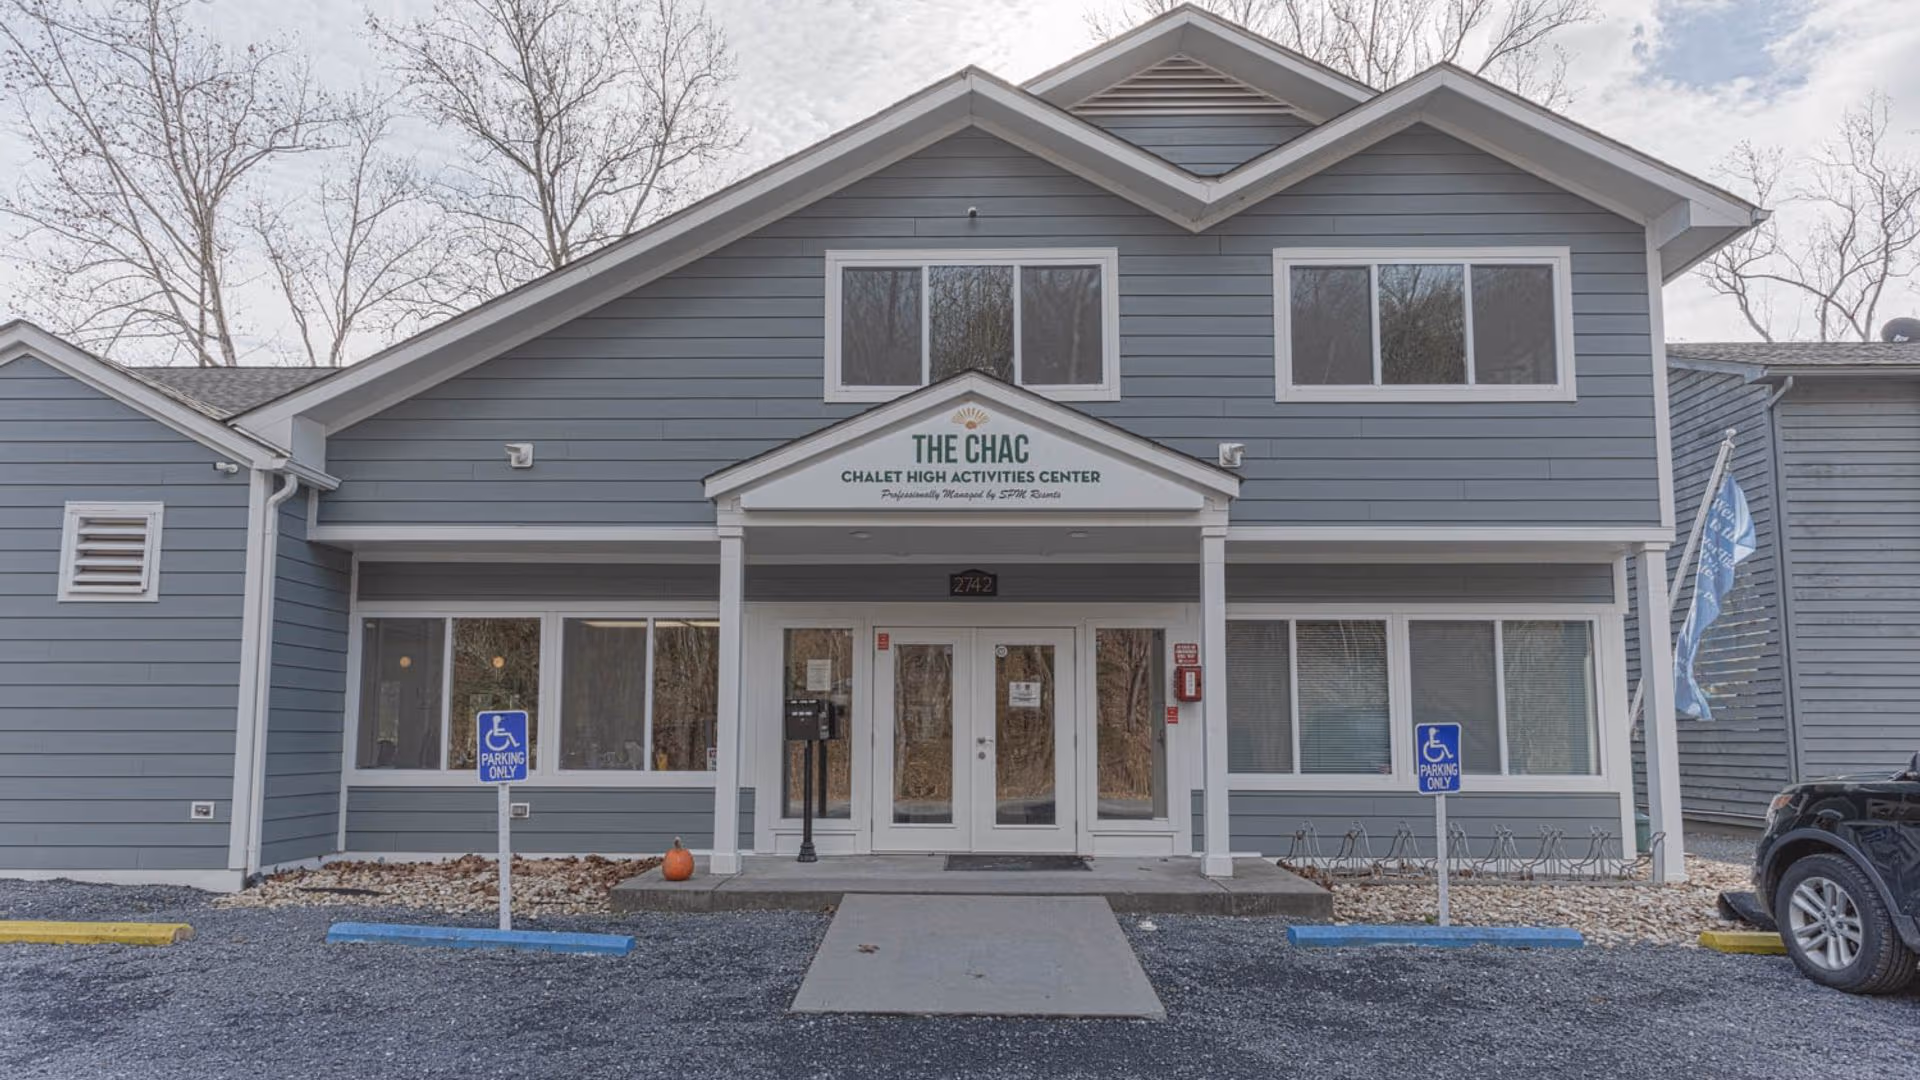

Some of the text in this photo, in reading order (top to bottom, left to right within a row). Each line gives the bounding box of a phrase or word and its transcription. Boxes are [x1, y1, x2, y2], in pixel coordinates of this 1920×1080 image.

[911, 434, 1029, 464] THE CHAC
[841, 470, 1101, 483] CHALET HIGH ACTIVITIES CENTER
[881, 488, 1062, 501] Professionally Managed by SPM Resorts
[953, 576, 993, 593] 2742
[481, 752, 525, 767] PARKING
[489, 765, 517, 779] ONLY
[1420, 763, 1458, 777] PARKING
[1427, 777, 1452, 790] ONLY
